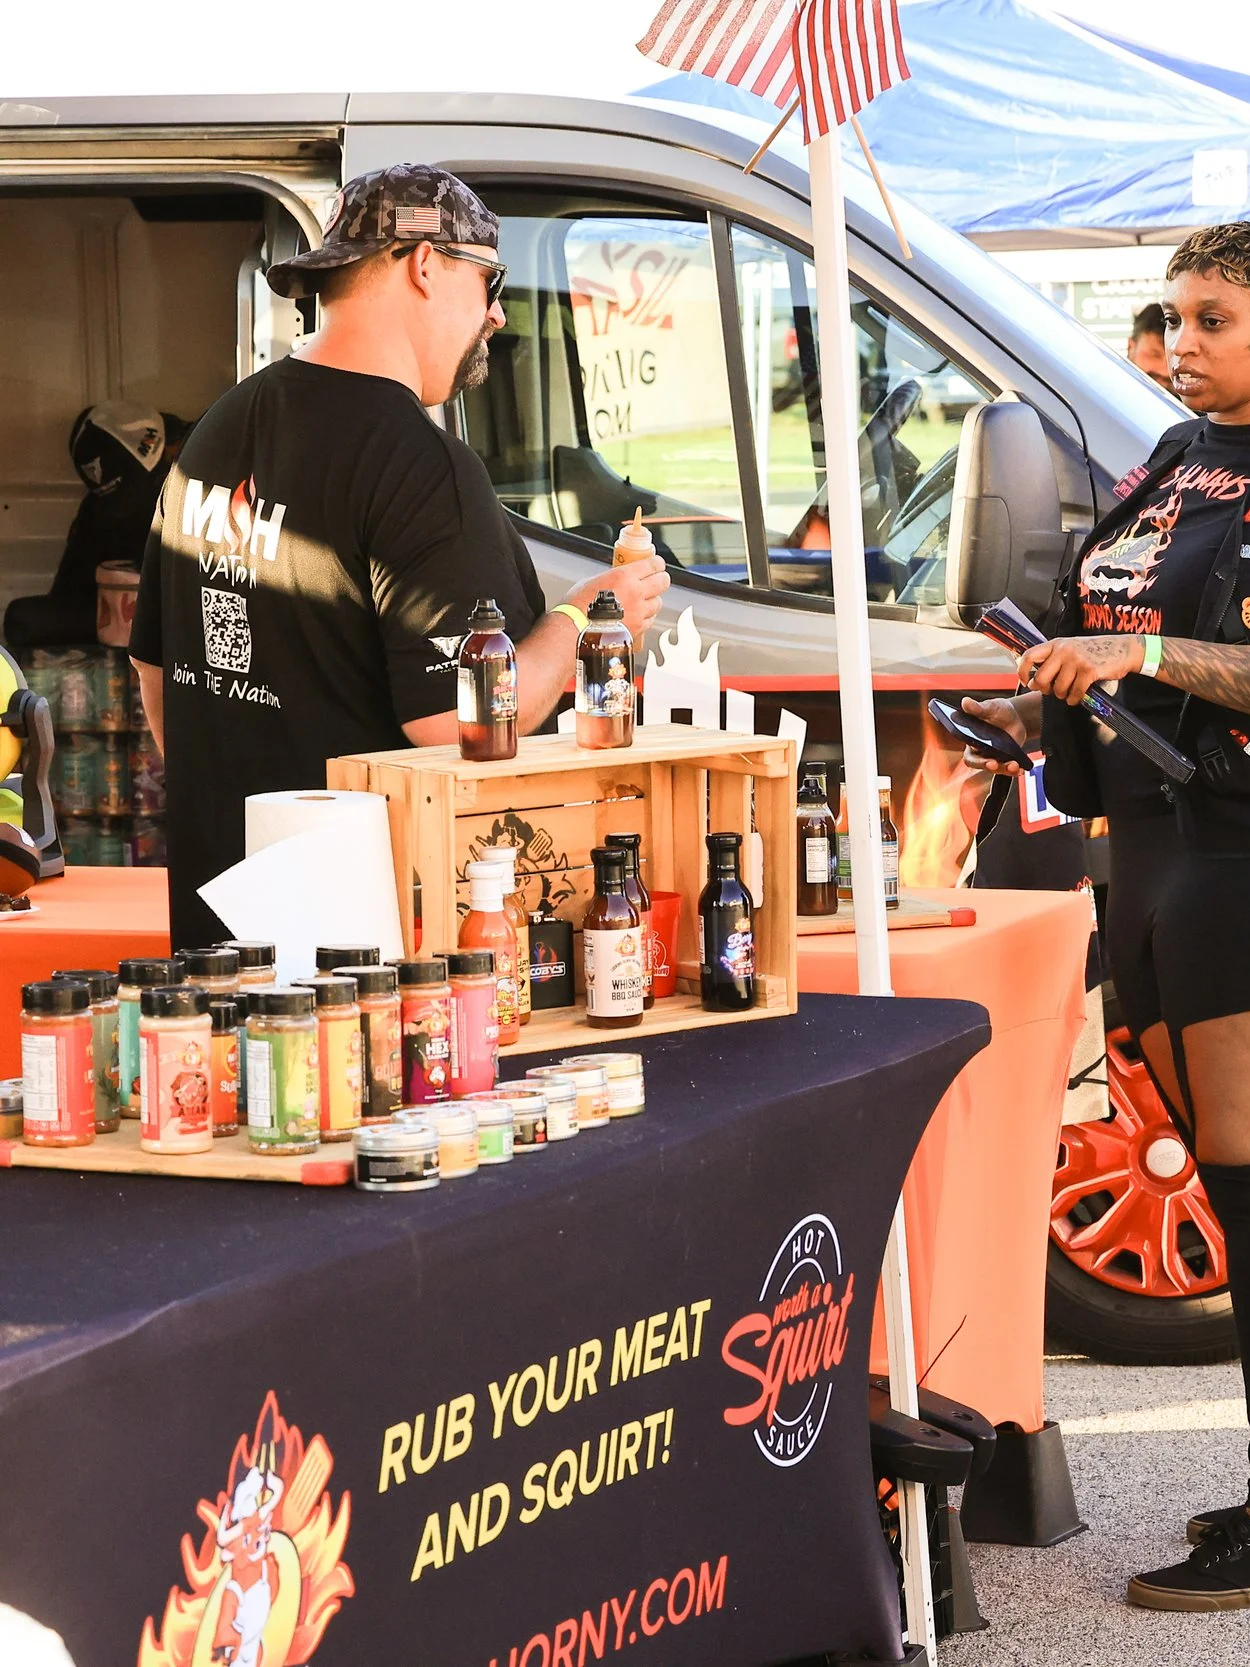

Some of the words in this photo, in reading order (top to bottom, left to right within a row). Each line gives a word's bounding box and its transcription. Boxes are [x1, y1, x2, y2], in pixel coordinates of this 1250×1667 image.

[1115, 604, 1162, 634] SEASON
[172, 662, 197, 686] Join
[203, 671, 222, 695] THE
[229, 680, 282, 709] Nation
[426, 660, 459, 673] PATR
[611, 991, 626, 1001] BBQ
[426, 1041, 449, 1055] HEX
[792, 1228, 825, 1263] HOT
[772, 1281, 810, 1328] worth
[810, 1284, 822, 1310] a
[721, 1273, 855, 1426] Squirt
[378, 1393, 476, 1494] RUB
[488, 1338, 603, 1440] YOUR
[609, 1299, 712, 1387] MEAT
[766, 1414, 815, 1456] SAUCE
[410, 1482, 511, 1583] AND
[519, 1408, 674, 1524] SQUIRT!
[488, 1555, 728, 1667] ORNY.COM
